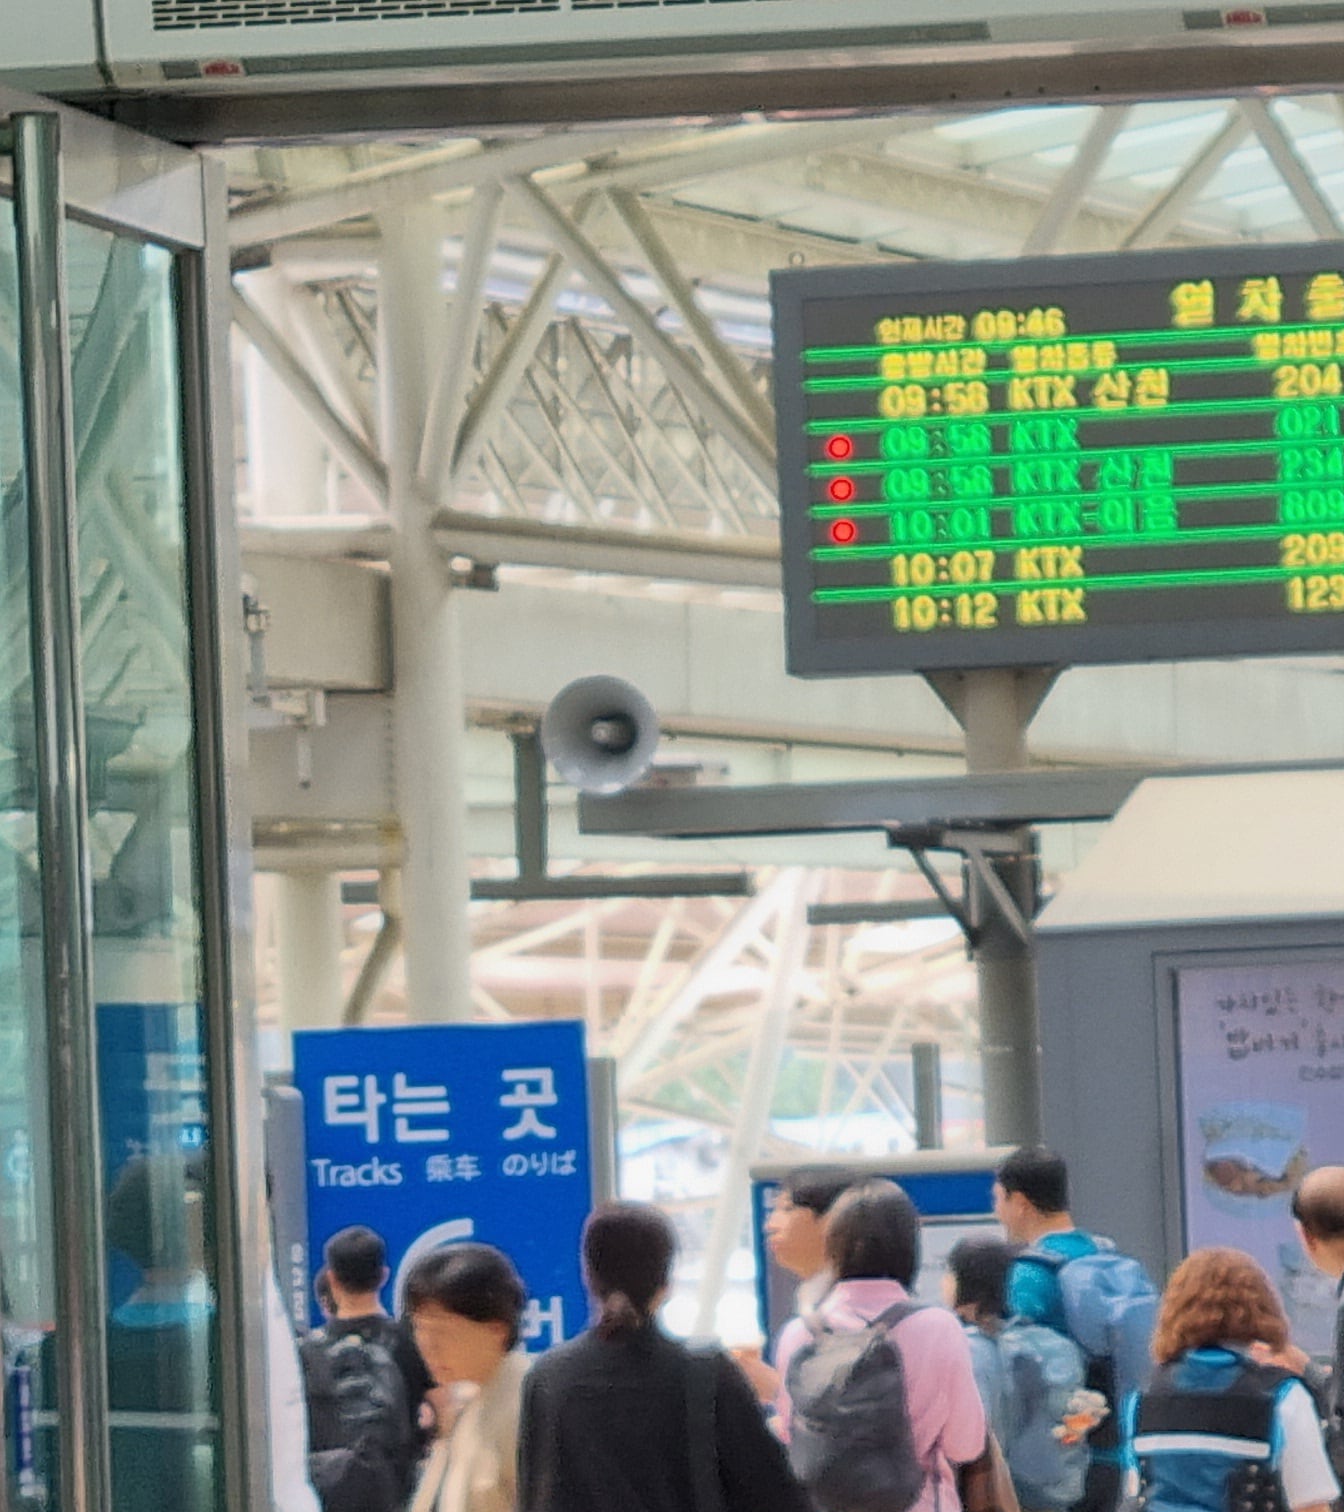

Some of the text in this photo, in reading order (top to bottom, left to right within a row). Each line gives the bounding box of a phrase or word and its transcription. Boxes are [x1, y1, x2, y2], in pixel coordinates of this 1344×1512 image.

[973, 307, 1066, 341] 09:46
[880, 381, 989, 417] 09:58
[1008, 375, 1077, 410] KTX
[1274, 363, 1343, 399] 204
[1011, 418, 1080, 452] KTX
[1275, 405, 1342, 438] 021
[1012, 459, 1081, 492] KTX
[891, 506, 991, 542] 10:01
[892, 550, 995, 586] 10:07
[1015, 545, 1084, 580] KTX
[893, 592, 998, 630] 10:12
[1016, 587, 1086, 624] KTX
[323, 1066, 559, 1145] 타는 곳
[310, 1156, 403, 1188] Tracks
[502, 1149, 577, 1177] のりば
